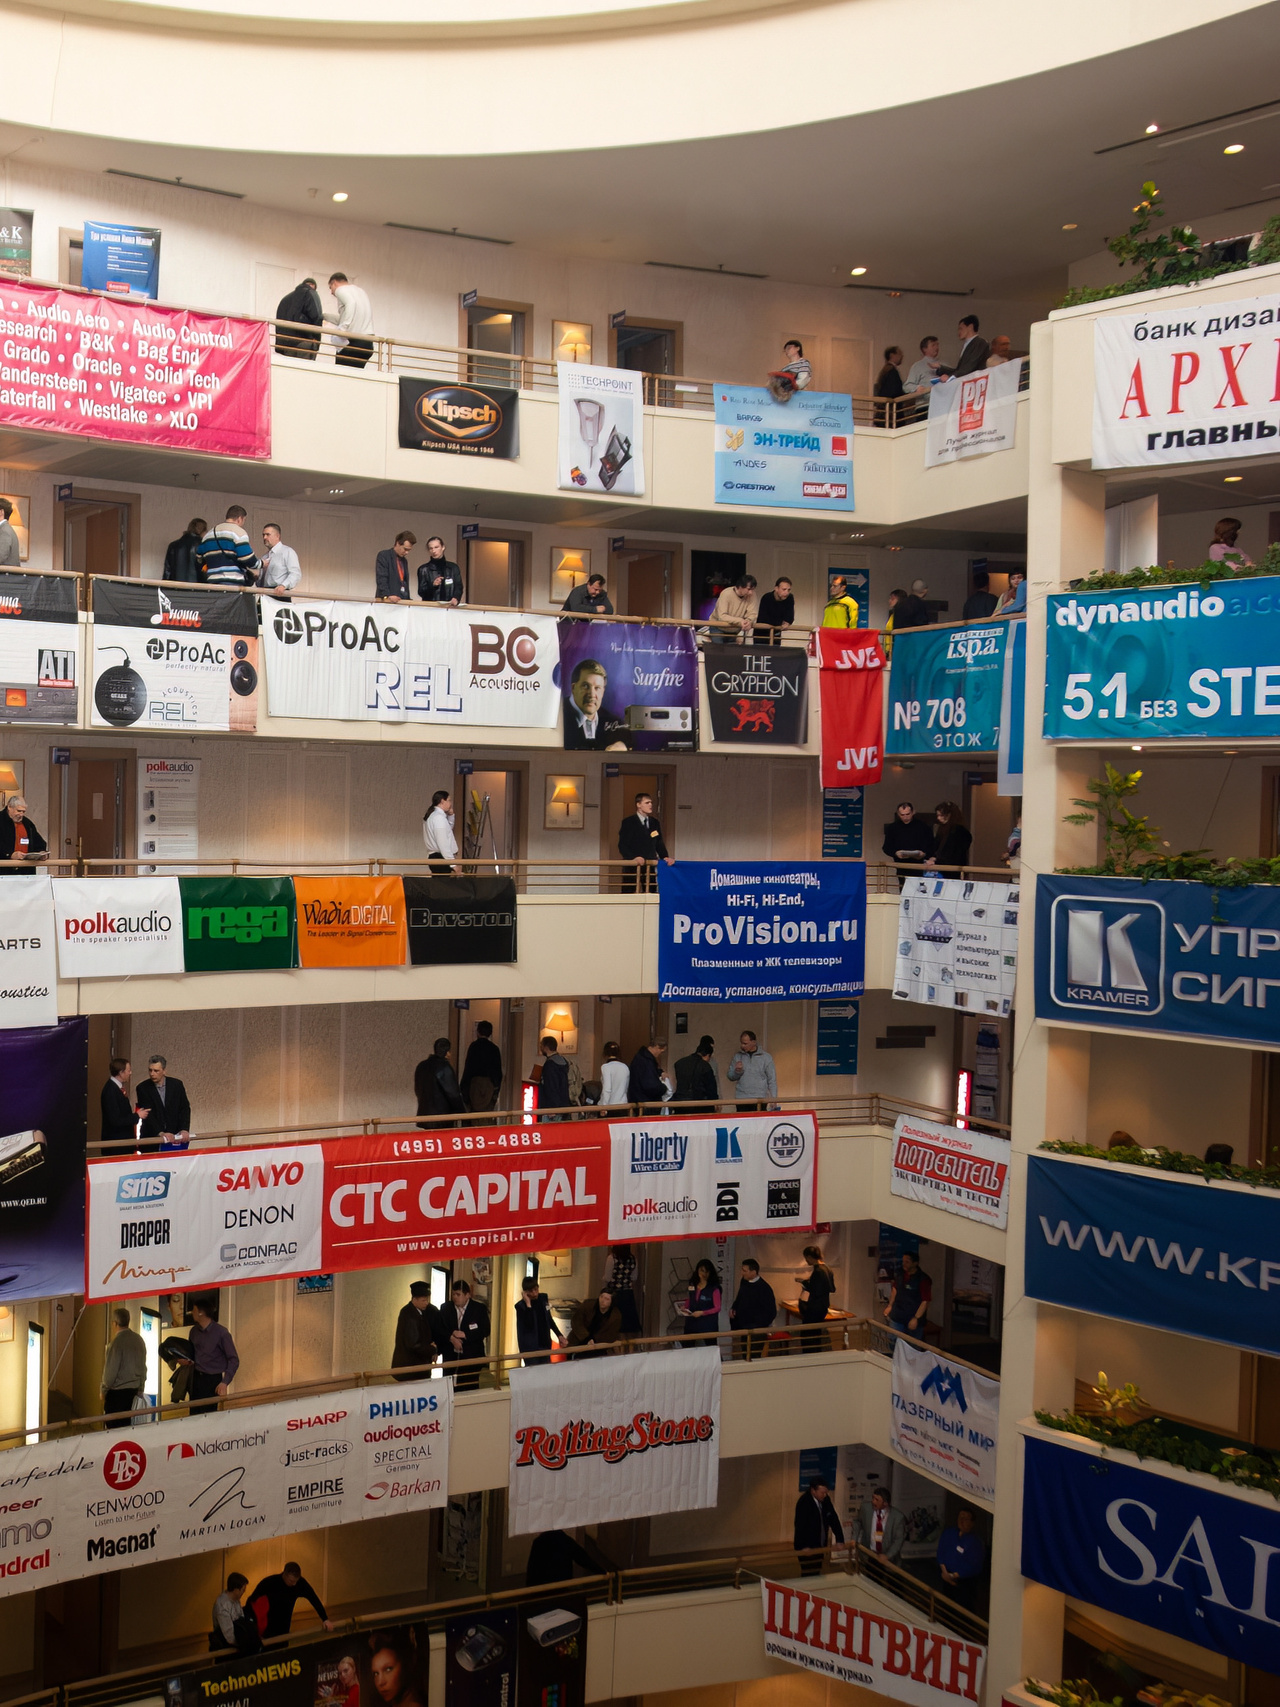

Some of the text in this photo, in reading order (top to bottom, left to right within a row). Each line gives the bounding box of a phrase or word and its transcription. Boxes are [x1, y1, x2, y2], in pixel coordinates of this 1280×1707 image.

[27, 300, 71, 323] Audio
[74, 308, 110, 330] Aero
[132, 319, 176, 341] Audio
[180, 325, 233, 349] Control
[1134, 320, 1196, 341] банк
[80, 331, 115, 353] B&K
[137, 340, 168, 365] Bag
[172, 344, 200, 365] End
[4, 339, 50, 365] Grado
[72, 354, 122, 377] Oracle
[144, 364, 183, 385] Solid
[187, 370, 221, 390] Tech
[581, 375, 633, 391] TECHPOINT
[110, 380, 167, 405] Vigatec
[188, 391, 213, 411] VPI
[962, 378, 987, 414] PC
[78, 398, 148, 424] Westlake
[169, 411, 198, 431] XLO
[421, 397, 497, 422] Klipsch
[422, 440, 446, 451] Klipsch
[753, 432, 821, 452] ЭН-ТРЕЙД
[1055, 591, 1225, 632] dynaudio
[304, 611, 400, 653] ProAc
[166, 639, 226, 664] ProAc
[469, 624, 540, 676] BC
[835, 647, 880, 669] JVC
[743, 655, 772, 672] THE
[365, 660, 463, 713] REL
[469, 675, 541, 694] Acoustique
[632, 666, 685, 692] Sunfire
[712, 672, 799, 696] GRYPHON
[1062, 672, 1178, 720] 5.1 БЕЗ
[149, 701, 197, 722] REL
[926, 697, 967, 728] 708
[933, 733, 981, 748] этаж
[837, 746, 878, 771] JVC
[710, 869, 821, 890] Домашние кинотеатры,
[726, 893, 805, 909] Hi-Fi, Hi-End,
[65, 909, 171, 940] polkaudio
[188, 905, 289, 943] rega
[673, 914, 858, 945] ProVision.ru
[89, 935, 121, 944] speaker
[124, 934, 168, 943] specialists
[691, 956, 842, 969] Плазменные и ЖК телевизоры
[662, 983, 787, 999] Доставка, установка,
[1066, 987, 1150, 1006] KRAMER
[393, 1132, 542, 1156] (495) 363-4888
[631, 1132, 688, 1166] Liberty
[773, 1133, 799, 1147] rbh
[120, 1175, 166, 1199] sms
[216, 1161, 304, 1194] SANYO
[329, 1166, 597, 1228] CTC CAPITAL
[622, 1196, 698, 1220] polkaudio
[716, 1181, 740, 1222] BDI
[224, 1203, 295, 1229] DENON
[238, 1241, 298, 1260] CONRAC
[397, 1230, 535, 1252] www.ctccapital.ru
[369, 1395, 438, 1420] PHILIPS
[287, 1410, 348, 1431] SHARP
[364, 1419, 441, 1443] audioquest
[195, 1433, 266, 1457] Nakamichi
[968, 1428, 995, 1452] МИР
[284, 1441, 348, 1467] just-racks
[374, 1444, 432, 1464] SPECTRAL
[385, 1461, 421, 1475] Germany
[287, 1477, 344, 1501] EMPIRE
[390, 1479, 441, 1499] Barkan
[86, 1490, 165, 1518] KENWOOD
[288, 1499, 343, 1515] audio furniture
[94, 1517, 114, 1527] Listen
[124, 1514, 135, 1523] the
[179, 1514, 267, 1540] MARTIN LOGAN
[87, 1526, 158, 1561] Magnat
[765, 1581, 982, 1702] ПИНГВИН
[201, 1659, 302, 1698] TechnoNEWS
